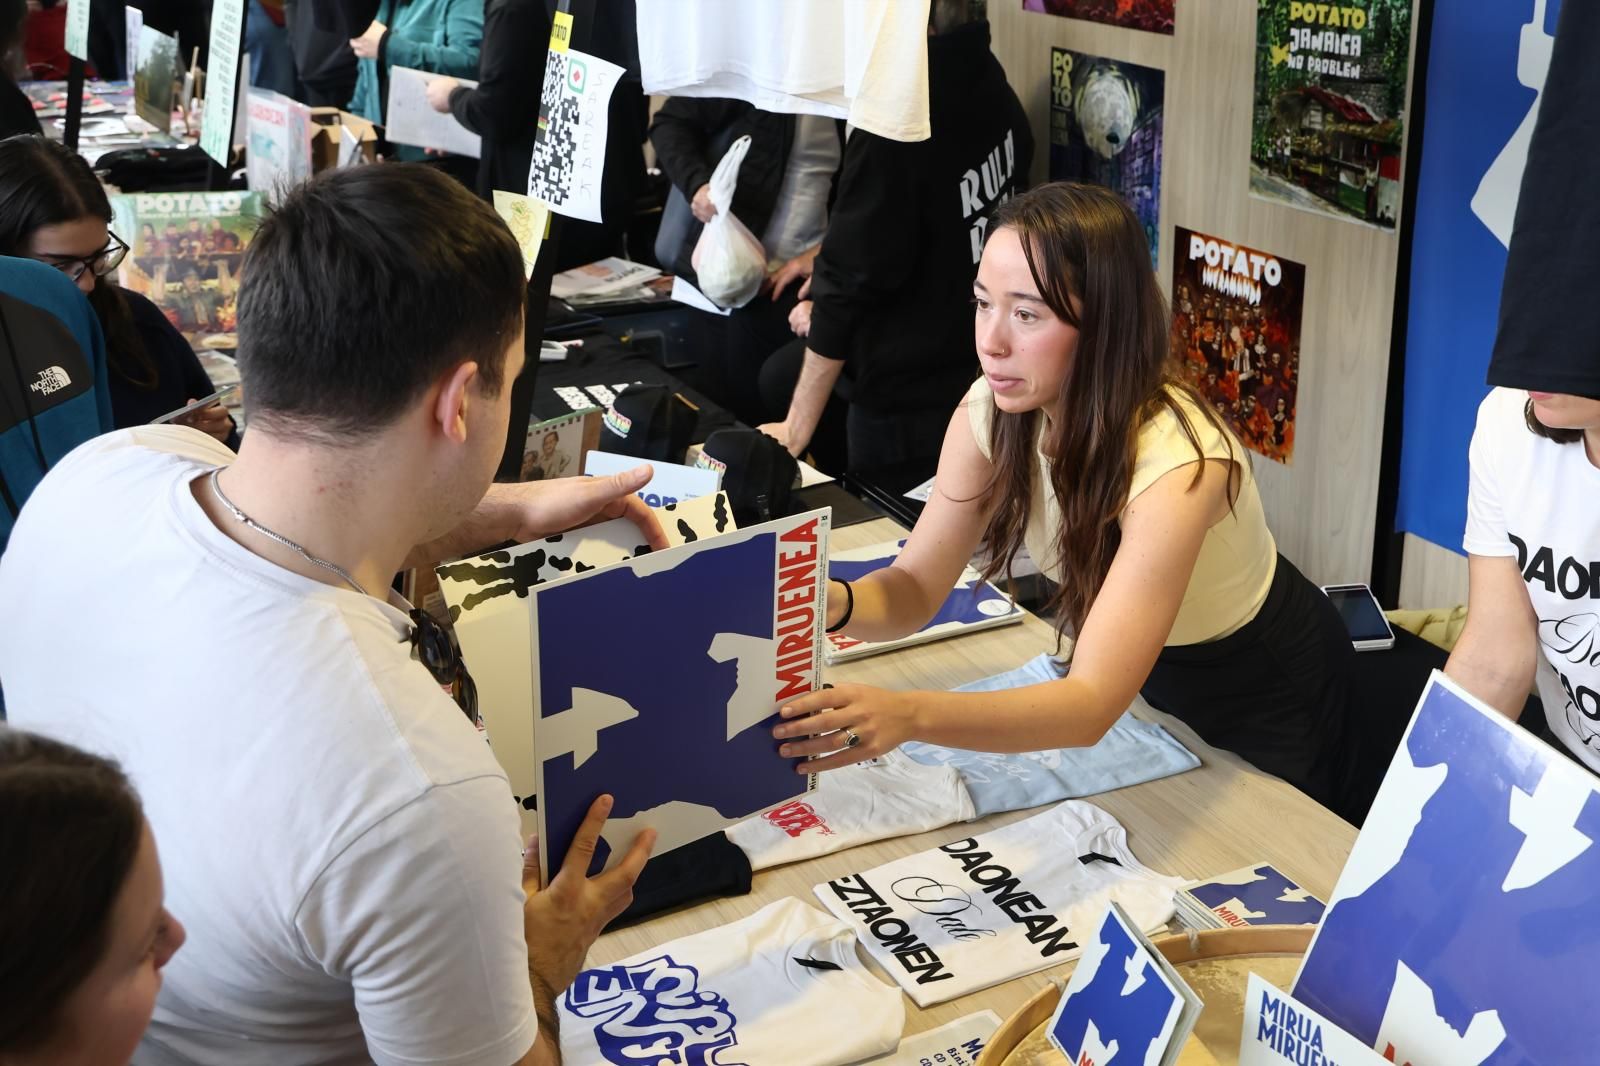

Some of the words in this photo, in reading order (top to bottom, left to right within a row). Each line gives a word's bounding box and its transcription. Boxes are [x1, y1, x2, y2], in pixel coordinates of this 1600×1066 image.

[1290, 2, 1366, 30] POTATO
[1290, 27, 1361, 56] JAMAICA
[1287, 53, 1304, 70] NO
[1307, 55, 1360, 79] PROBLEM
[136, 191, 242, 215] POTATO
[1189, 234, 1282, 287] POTATO
[30, 375, 58, 392] NORTH
[37, 367, 54, 380] THE
[42, 382, 61, 396] FACE
[776, 517, 819, 702] MIRUENEA
[938, 837, 1079, 958] DAONEAN
[1260, 989, 1323, 1053] MIRUA
[934, 1053, 947, 1063] CD
[947, 1047, 970, 1066] Bini
